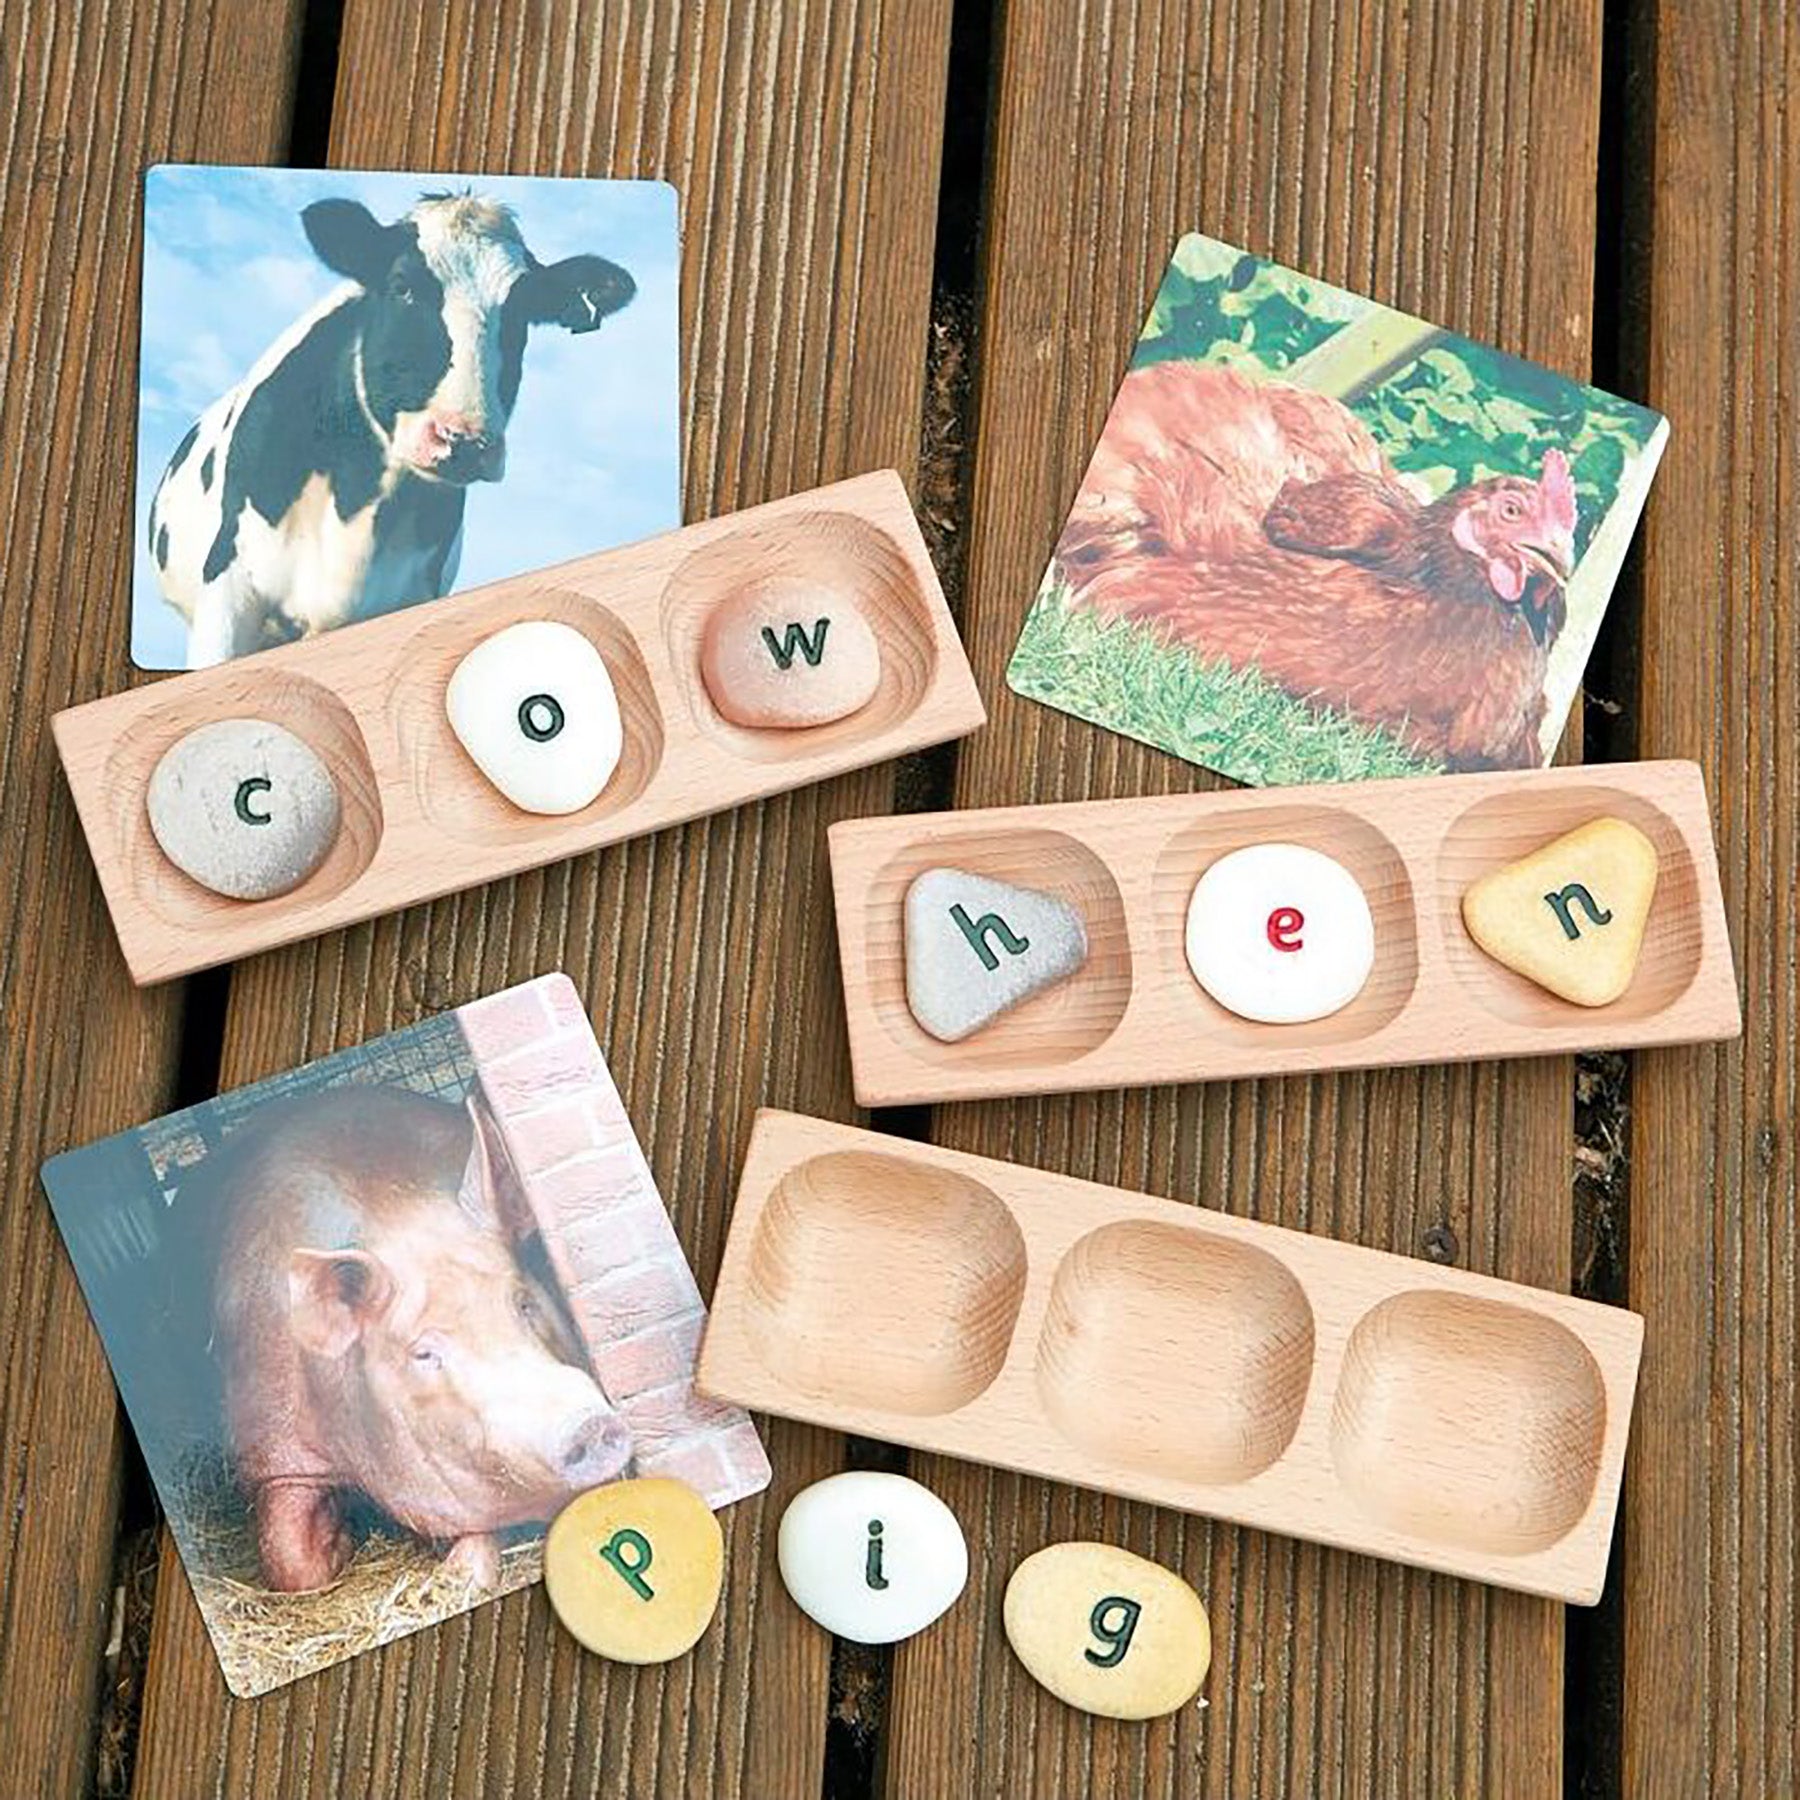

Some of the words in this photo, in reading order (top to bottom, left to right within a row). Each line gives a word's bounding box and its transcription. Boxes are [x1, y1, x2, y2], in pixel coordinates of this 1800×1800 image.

[234, 777, 271, 825] c
[518, 694, 565, 742] o
[761, 617, 830, 669] w
[949, 904, 1030, 971] h
[1267, 907, 1304, 952] e
[1544, 883, 1613, 940] n
[599, 1529, 654, 1602] p
[866, 1520, 889, 1590] i
[1084, 1596, 1142, 1668] g
